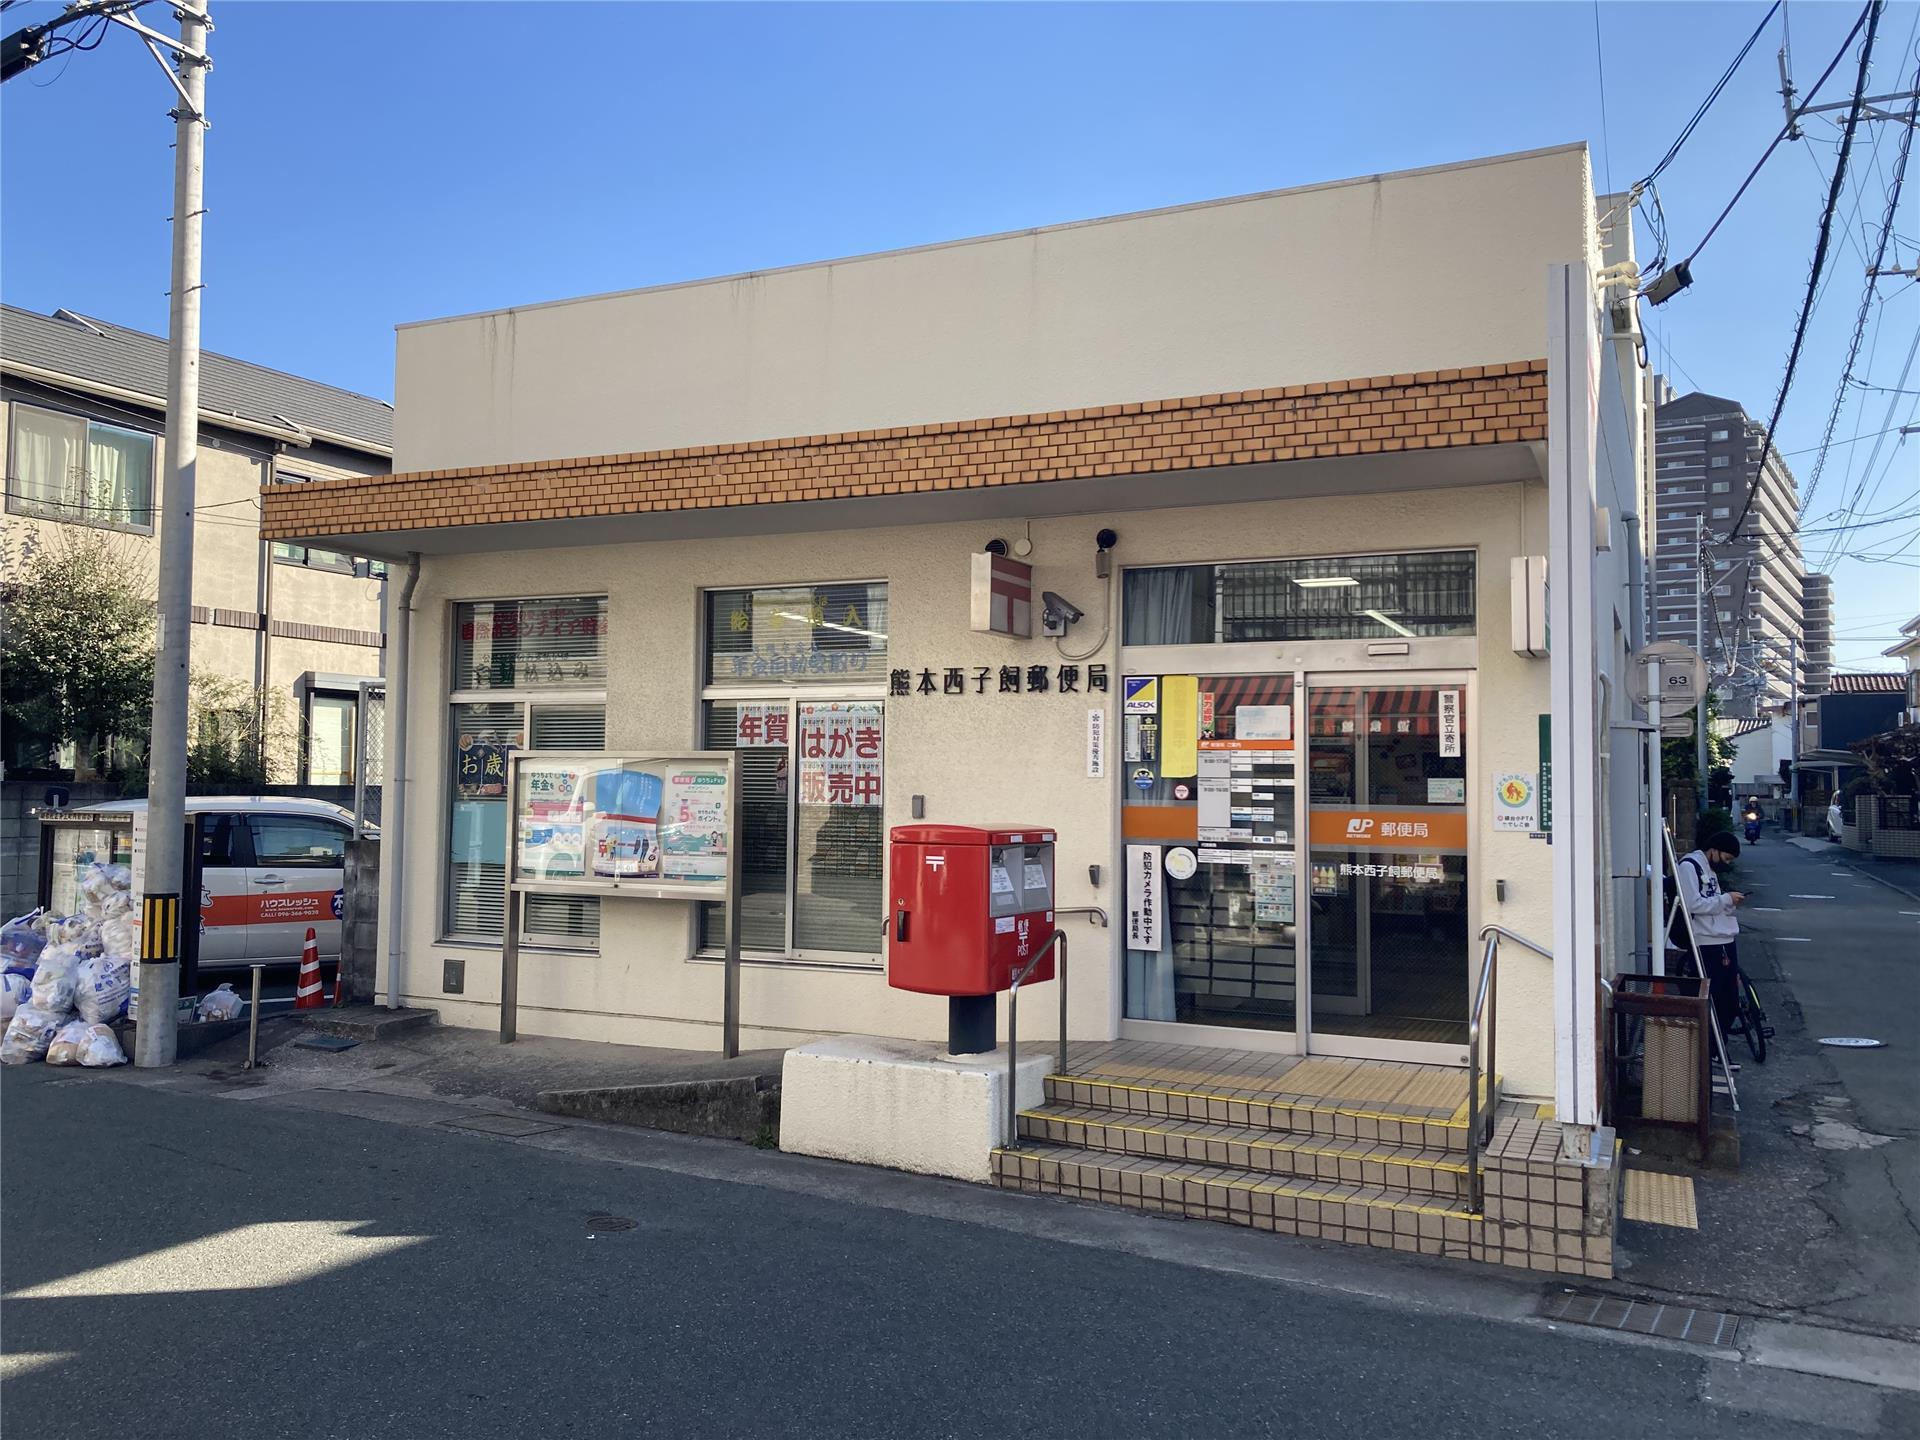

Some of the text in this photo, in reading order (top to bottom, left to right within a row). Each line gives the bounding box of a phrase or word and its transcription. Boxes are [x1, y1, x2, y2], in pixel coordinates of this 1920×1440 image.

[889, 663, 1108, 696] 熊本西子飼郵便局
[1669, 676, 1687, 684] 63
[1126, 701, 1154, 709] ALSOK
[739, 713, 788, 745] 年賀
[1443, 694, 1456, 753] 警察官立寄所
[801, 726, 881, 758] はがき
[531, 779, 554, 791] 年金を
[802, 771, 881, 804] 販売中
[1347, 818, 1428, 838] JP 郵便局
[1340, 863, 1438, 880] 熊本西子飼郵便局
[260, 897, 319, 909] ハウスレッシュ
[1143, 851, 1152, 944] 防犯カメラ作動中です
[1018, 944, 1029, 957] POST
